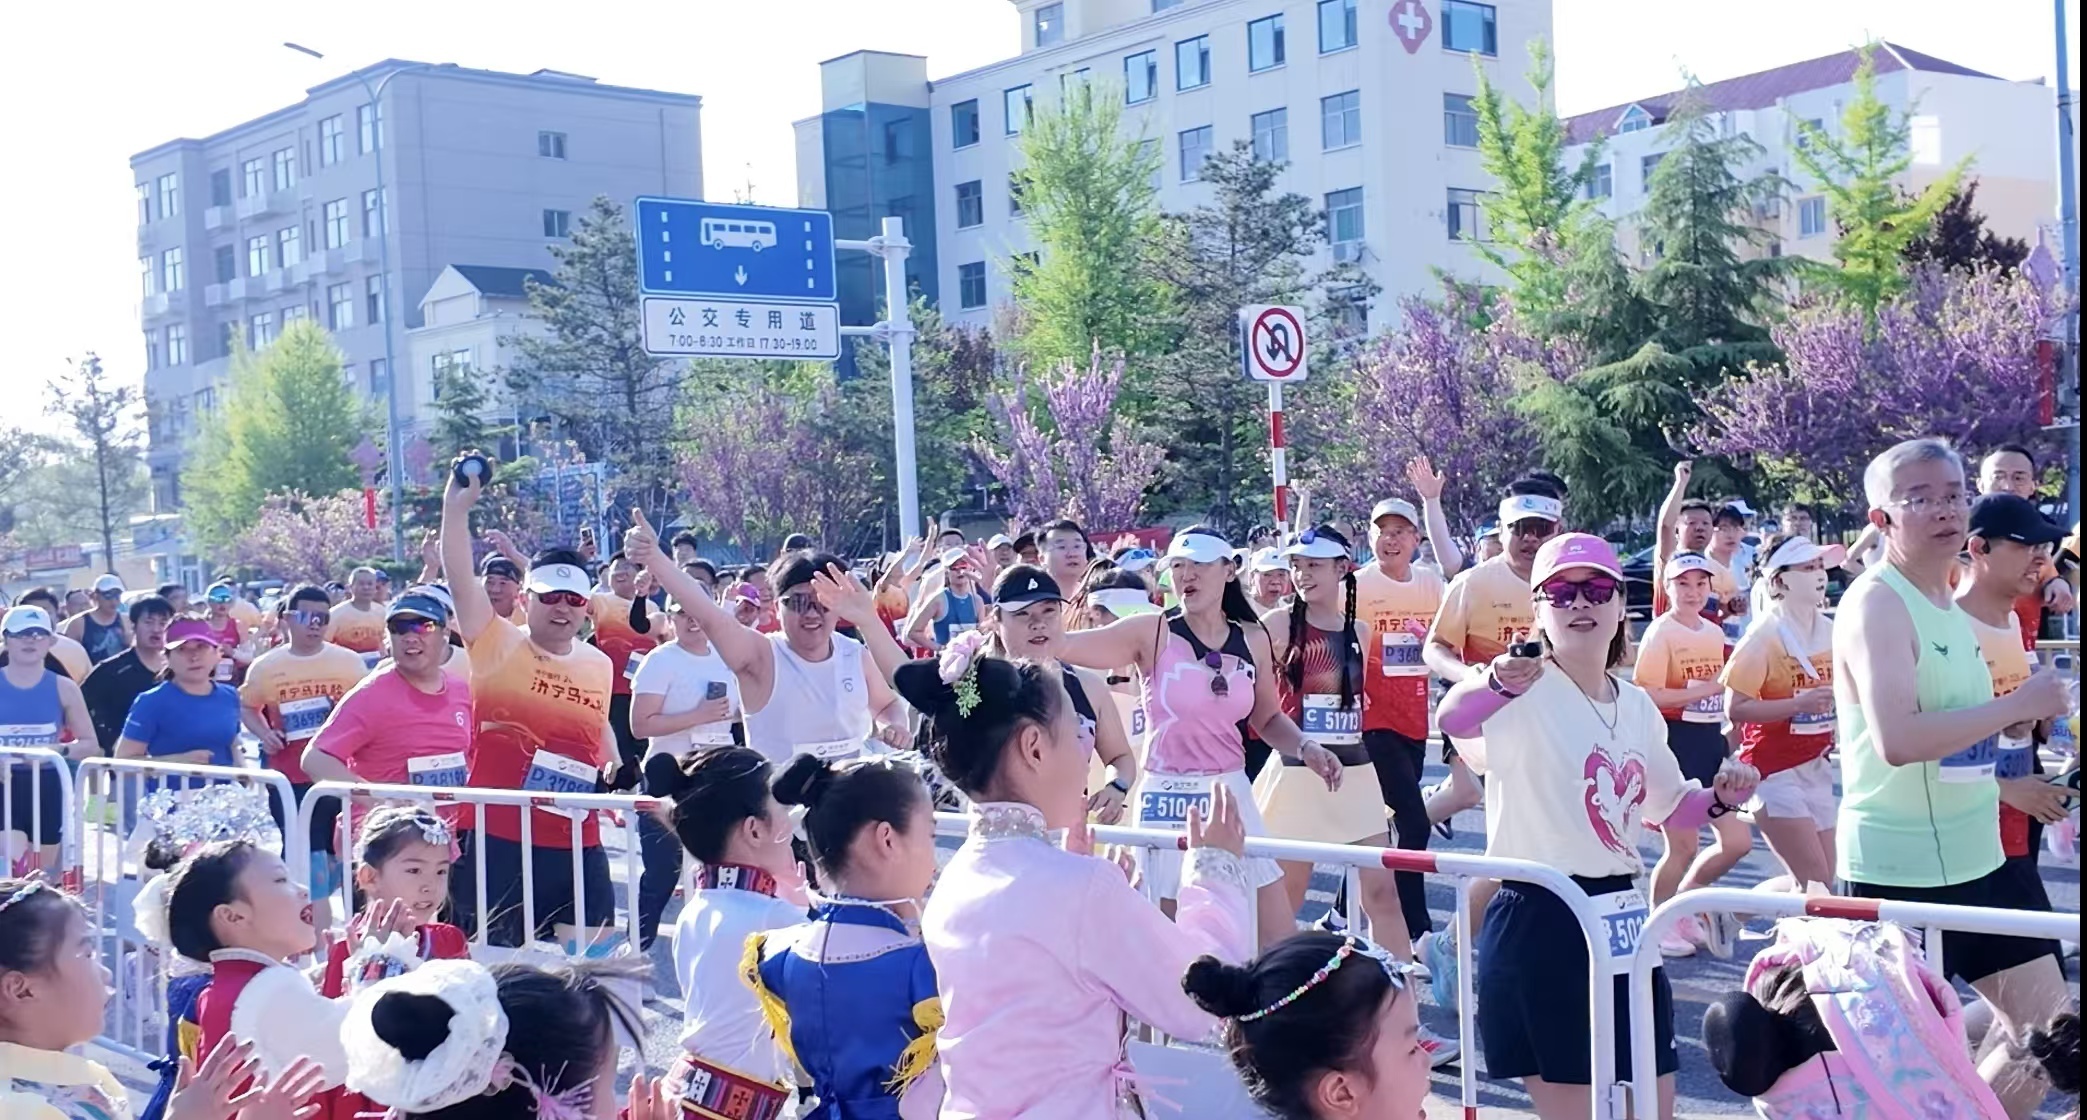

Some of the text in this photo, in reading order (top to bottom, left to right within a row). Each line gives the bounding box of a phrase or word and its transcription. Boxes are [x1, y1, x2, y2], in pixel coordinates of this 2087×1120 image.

[669, 306, 816, 331] 公交专用道
[1306, 709, 1358, 730] C 51713
[412, 773, 424, 785] D
[531, 767, 545, 781] D
[1142, 794, 1152, 808] C
